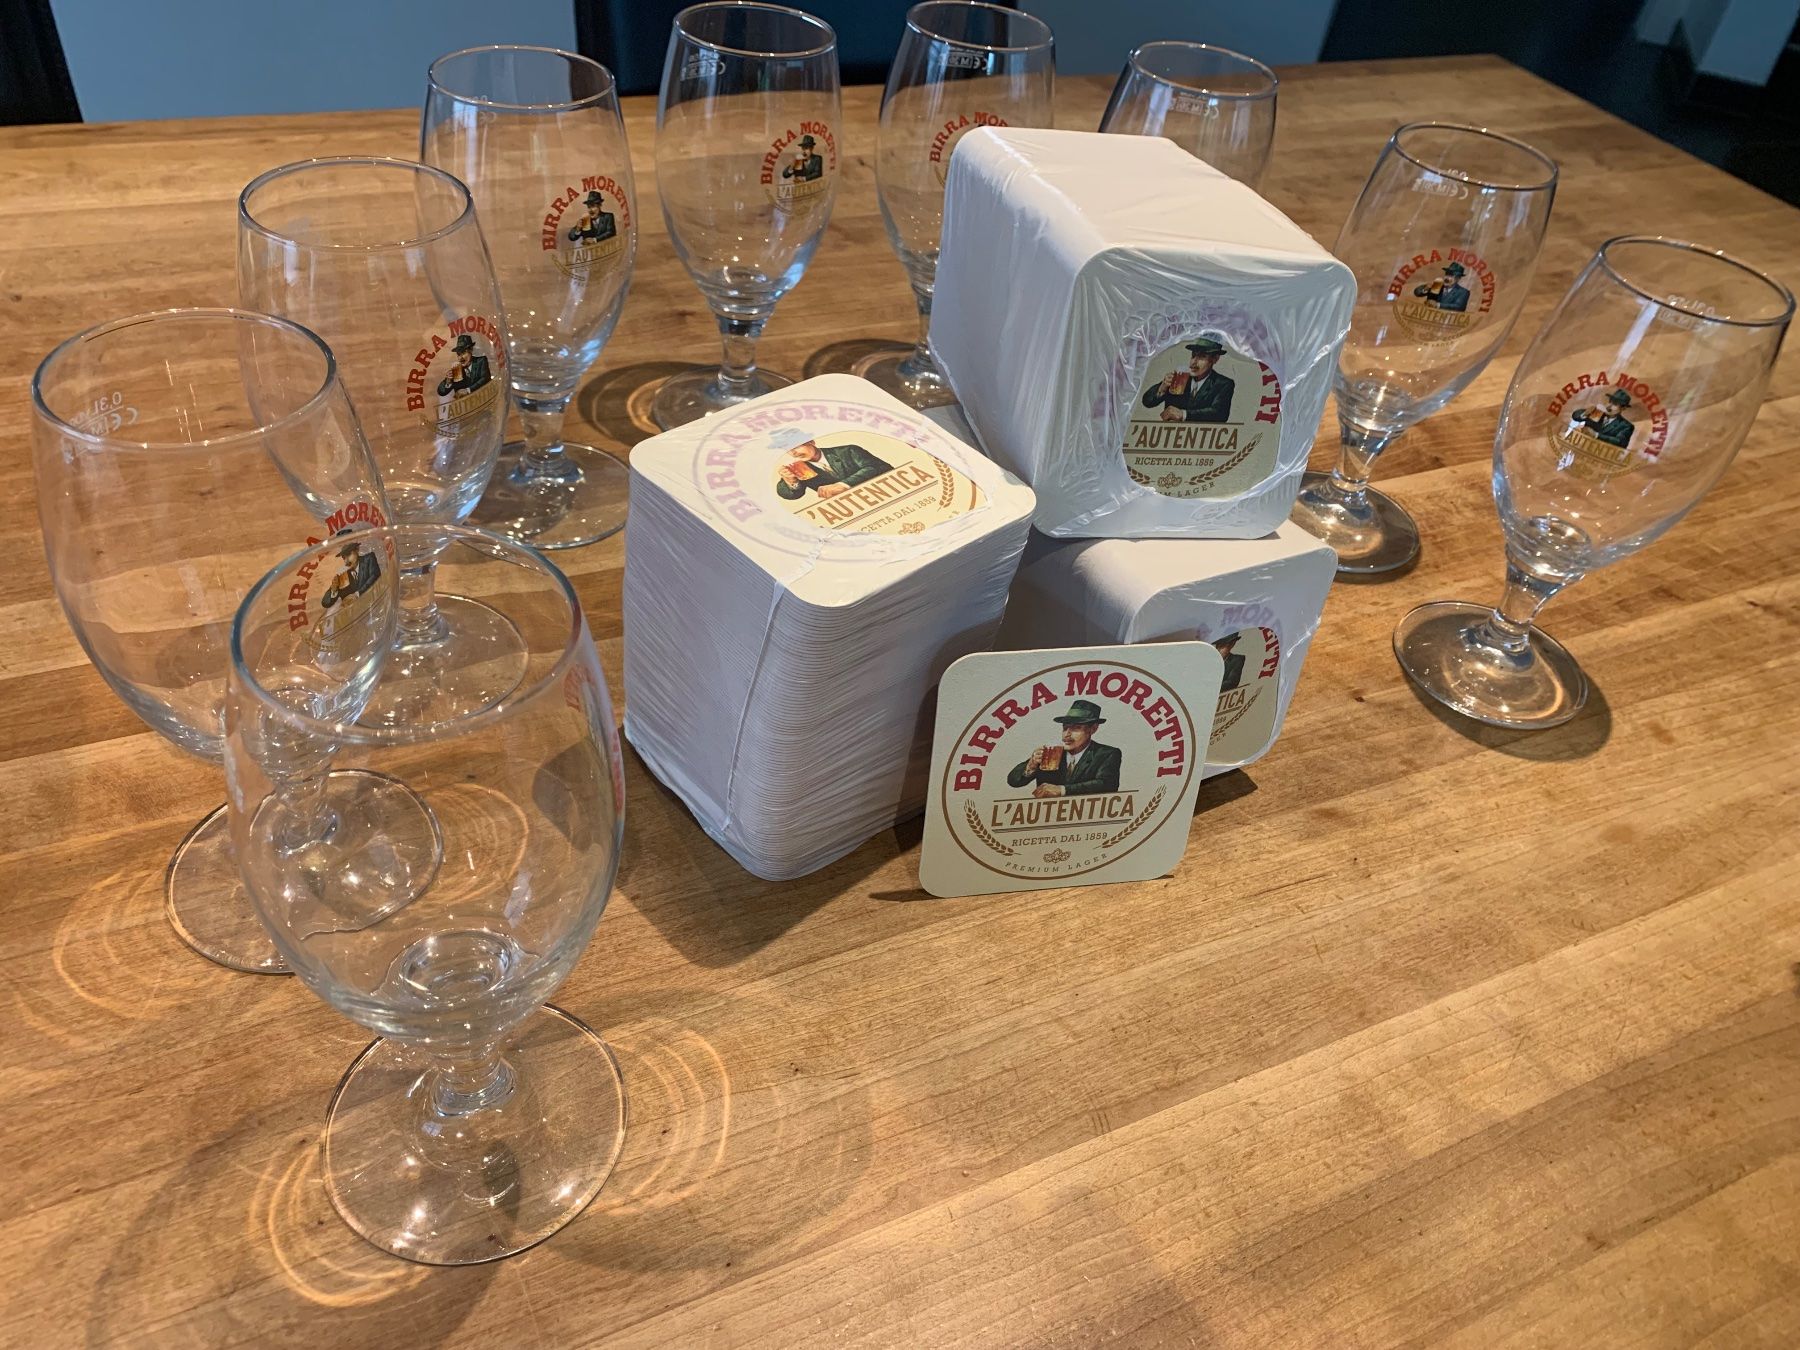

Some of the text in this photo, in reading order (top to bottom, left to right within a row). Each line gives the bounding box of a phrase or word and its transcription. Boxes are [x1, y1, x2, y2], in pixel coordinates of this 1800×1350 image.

[761, 121, 836, 184] BIRRA MORETTI
[930, 115, 970, 162] BIRRA
[542, 175, 631, 251] BIRRA MORETTI
[1388, 248, 1495, 313] BIRRA MORETTI
[407, 334, 448, 411] BIRRA
[1548, 371, 1668, 457] BIRRA MORETTI
[705, 430, 754, 524] BIRRA
[1134, 456, 1172, 466] RICETTA
[1174, 457, 1193, 467] DAL
[805, 464, 936, 529] 'AUTENTICA
[894, 505, 917, 519] DAL
[287, 537, 331, 632] BIRRA
[954, 670, 1185, 791] BIRRA MORETTI
[991, 794, 1135, 828] L'AUTENTICA
[1011, 831, 1109, 847] RICETTA DAL 1859
[1004, 853, 1109, 874] PREMIUM LAGER
